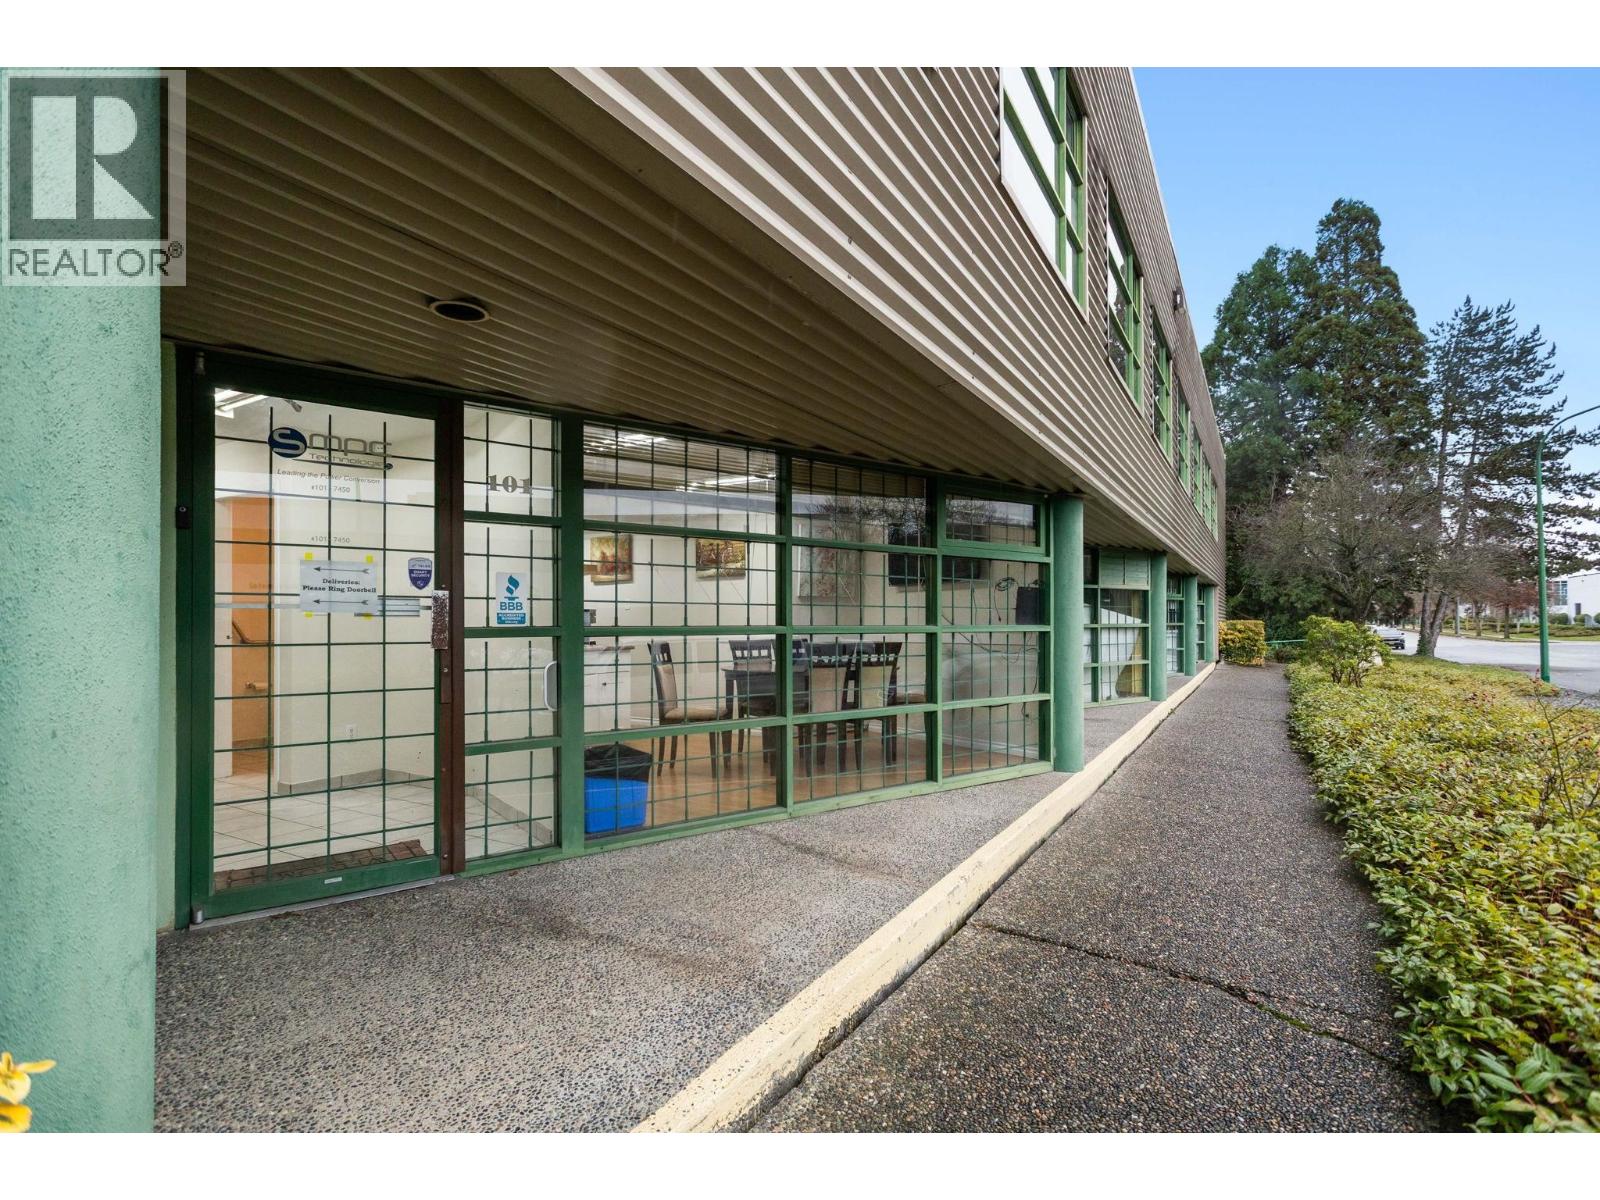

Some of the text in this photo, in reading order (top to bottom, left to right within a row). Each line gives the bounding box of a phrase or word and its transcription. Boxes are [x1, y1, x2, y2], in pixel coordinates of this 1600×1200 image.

[487, 474, 532, 495] 101
[328, 585, 346, 593] Ring
[500, 601, 523, 611] BBB
